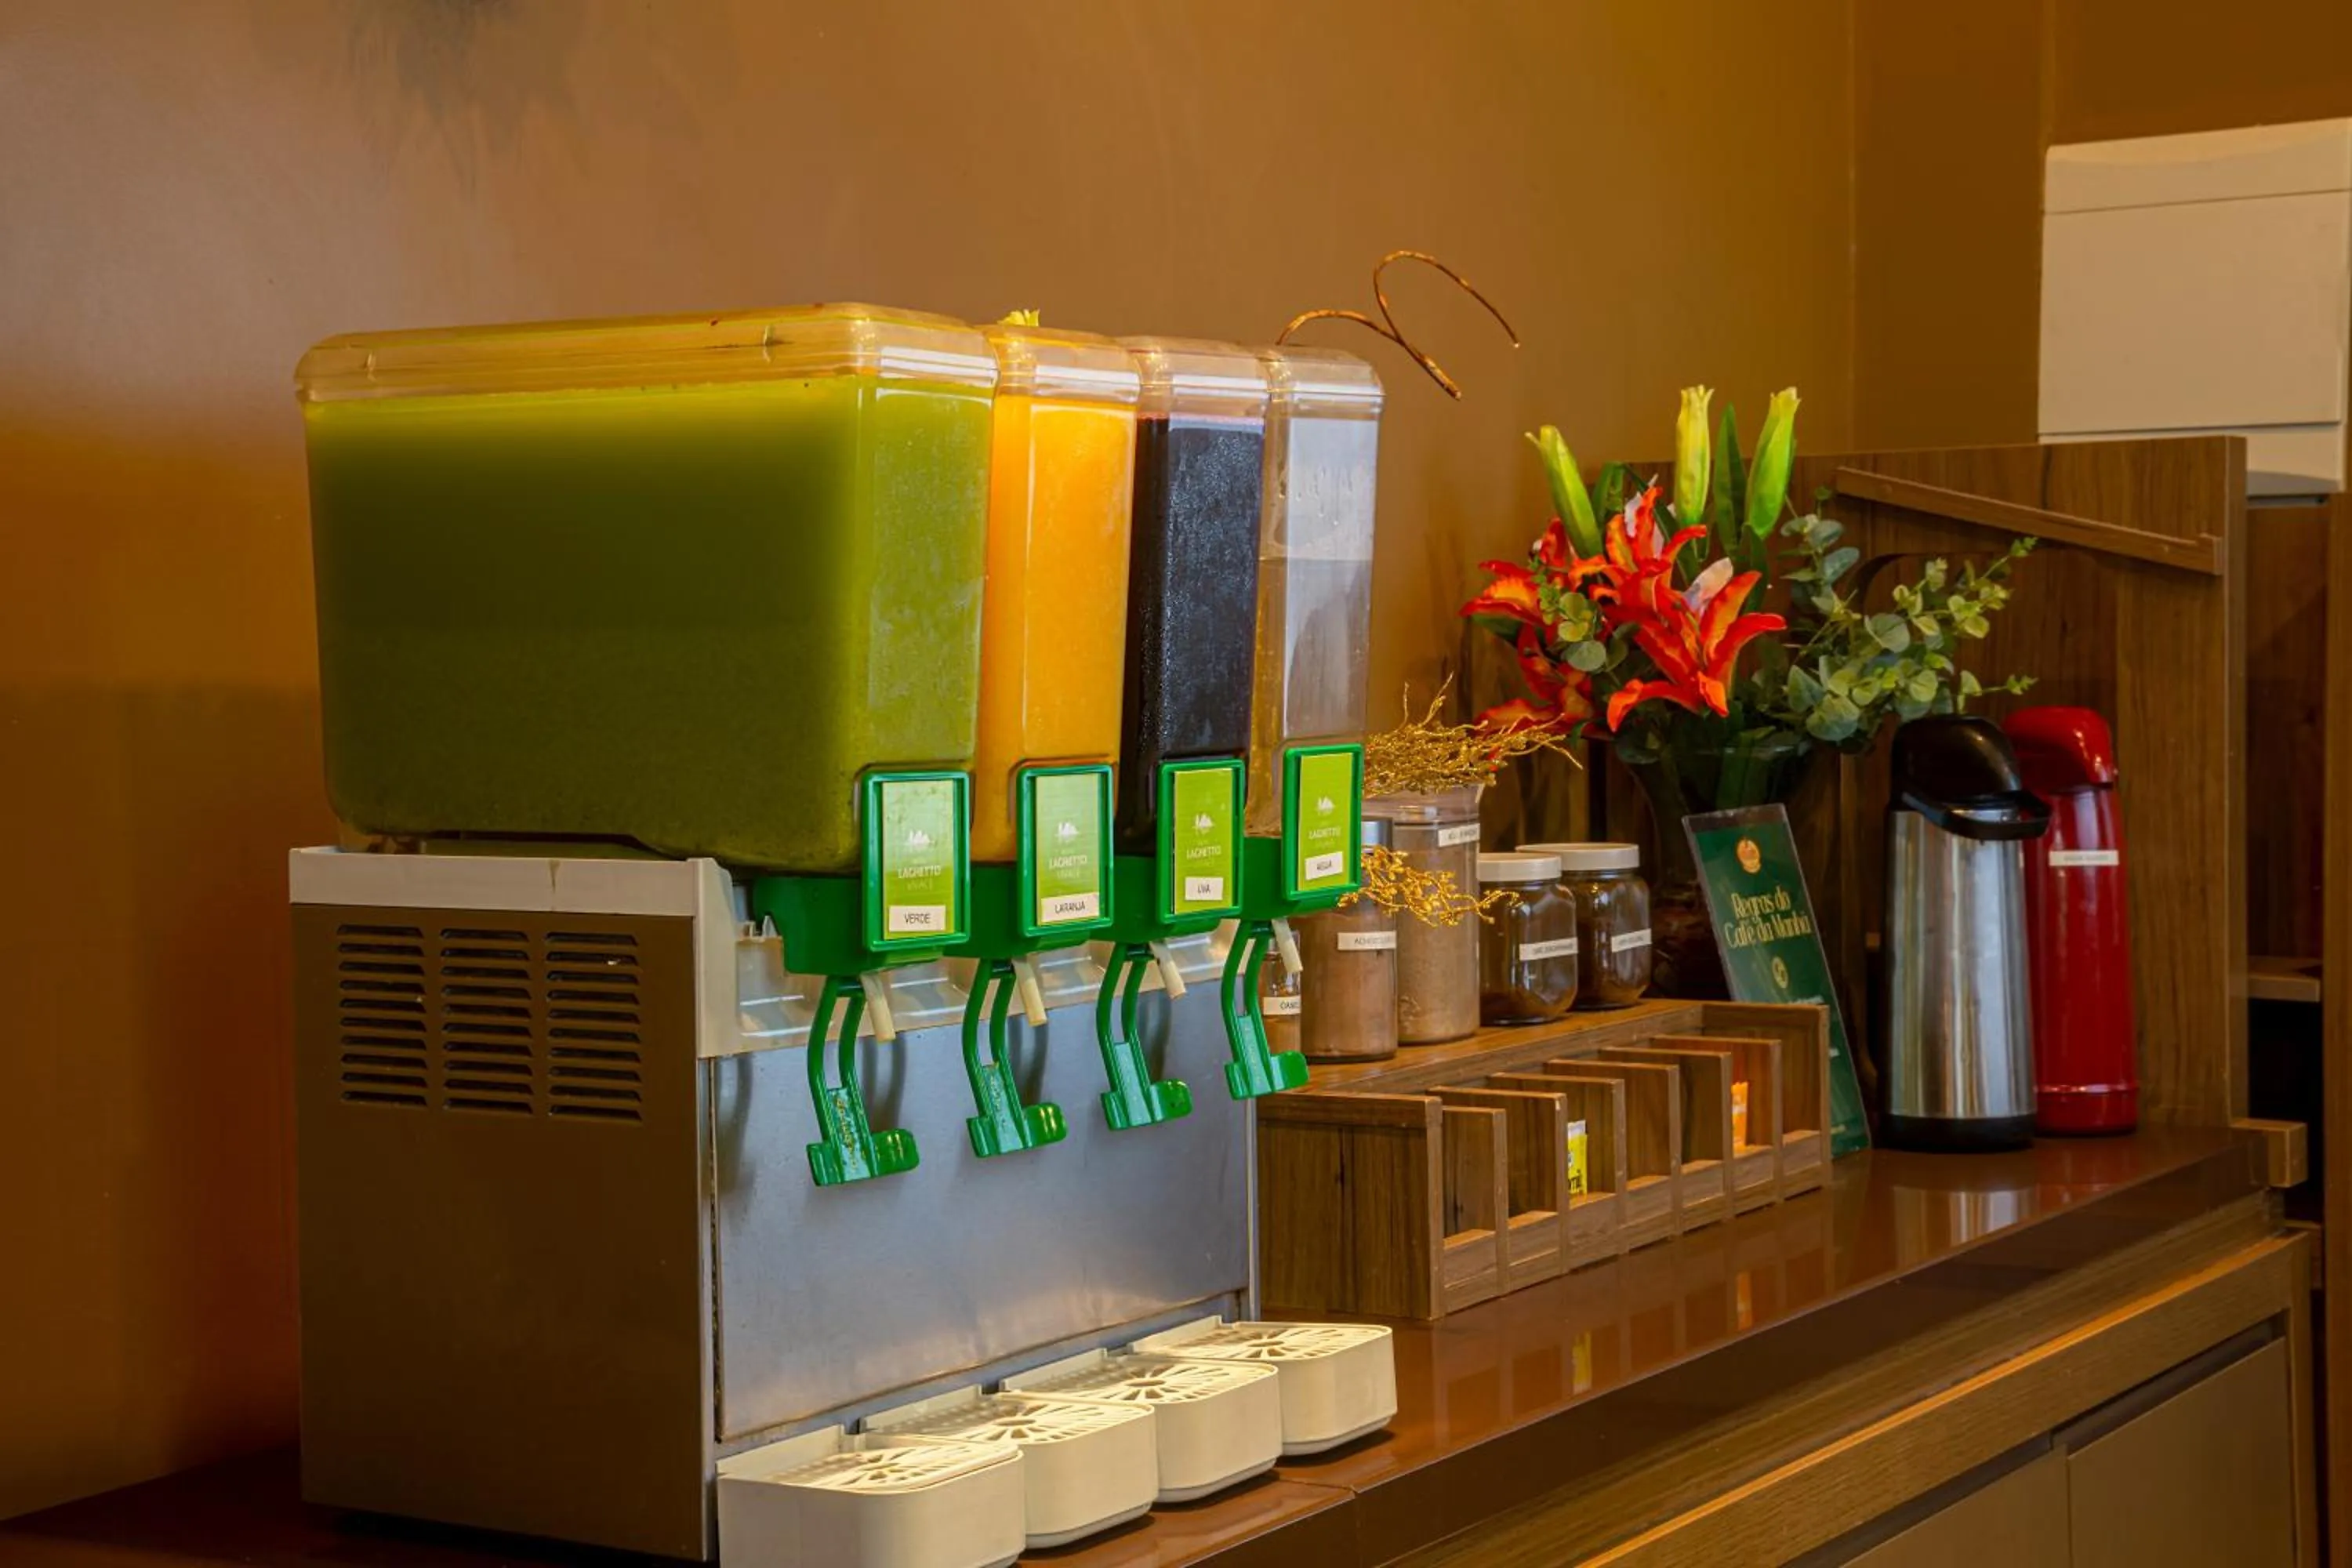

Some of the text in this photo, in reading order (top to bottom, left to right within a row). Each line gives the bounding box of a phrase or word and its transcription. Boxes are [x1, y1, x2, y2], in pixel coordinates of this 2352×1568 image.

[1187, 845, 1221, 860] LAGHETTO
[1049, 855, 1087, 869] LAGHETTO
[898, 865, 942, 879] LAGHETTO
[1054, 901, 1086, 914] LARANJA
[1731, 886, 1791, 924] Regras do
[904, 913, 931, 924] VERDE
[1725, 910, 1812, 949] Café da Manhã
